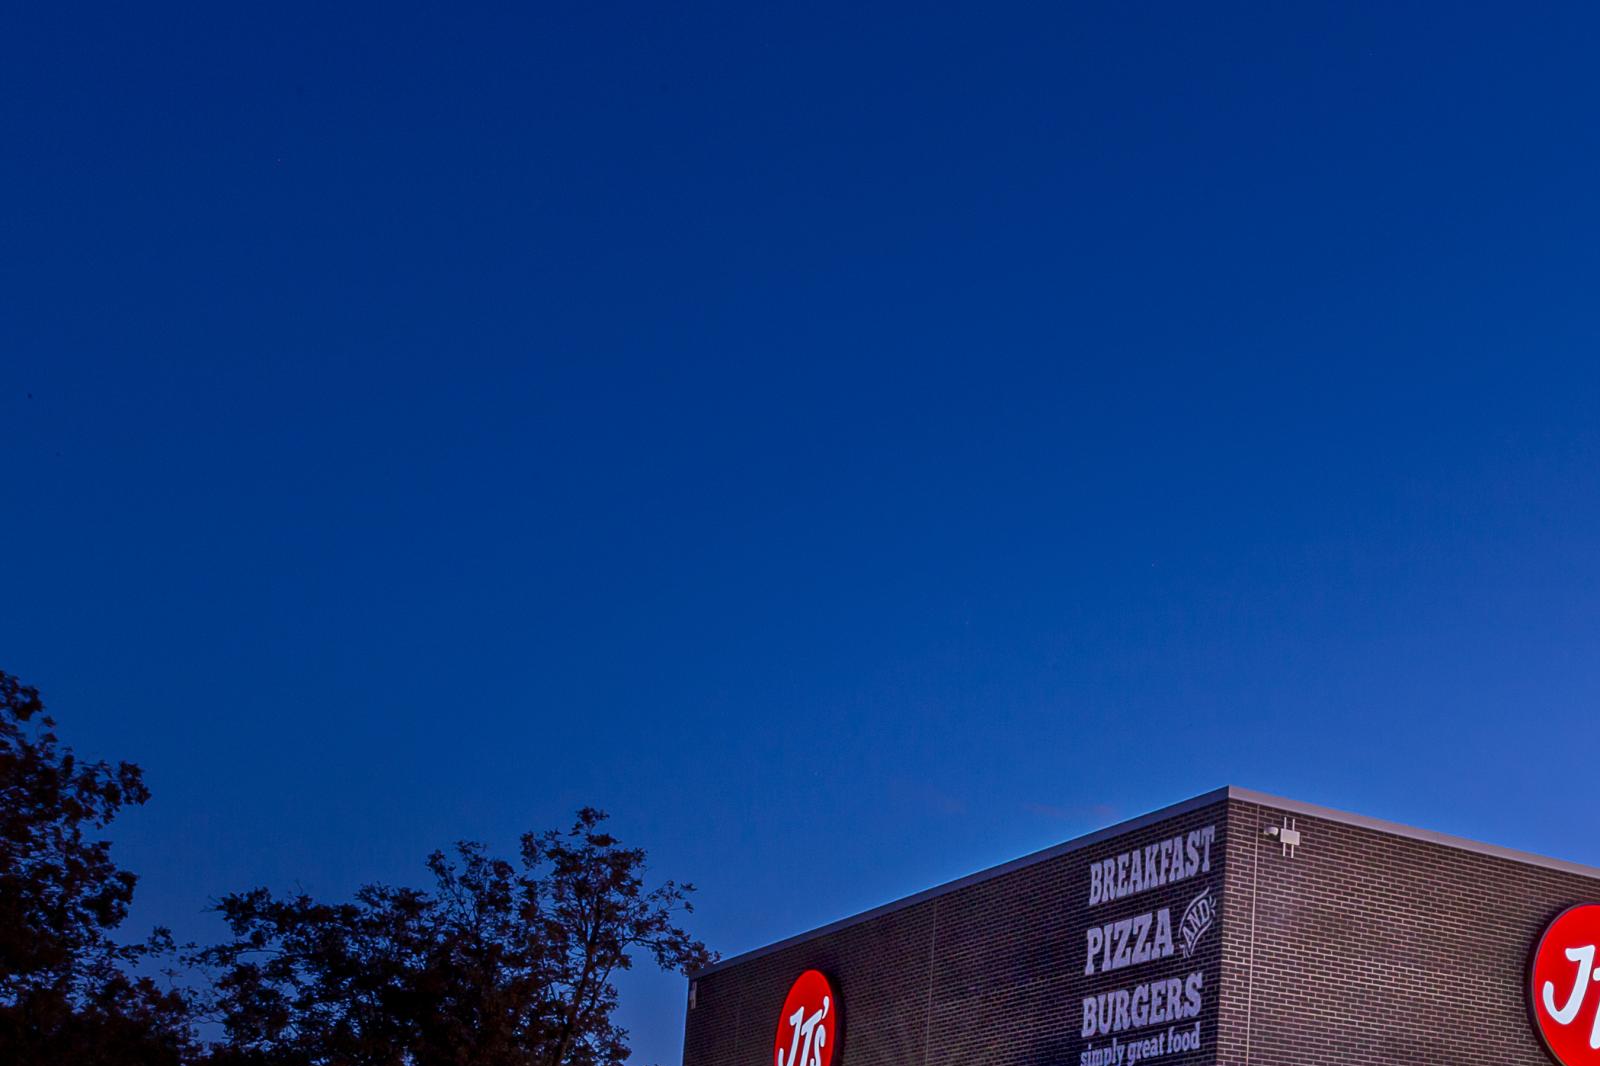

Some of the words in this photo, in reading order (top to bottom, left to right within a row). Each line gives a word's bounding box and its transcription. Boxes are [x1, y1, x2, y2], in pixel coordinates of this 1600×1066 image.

[1089, 825, 1215, 906] BREAKFAST
[1084, 908, 1174, 975] PIZZA
[1182, 901, 1210, 946] AND
[1080, 972, 1203, 1038] BURGERS
[1127, 1033, 1164, 1066] great
[1167, 1022, 1200, 1055] food
